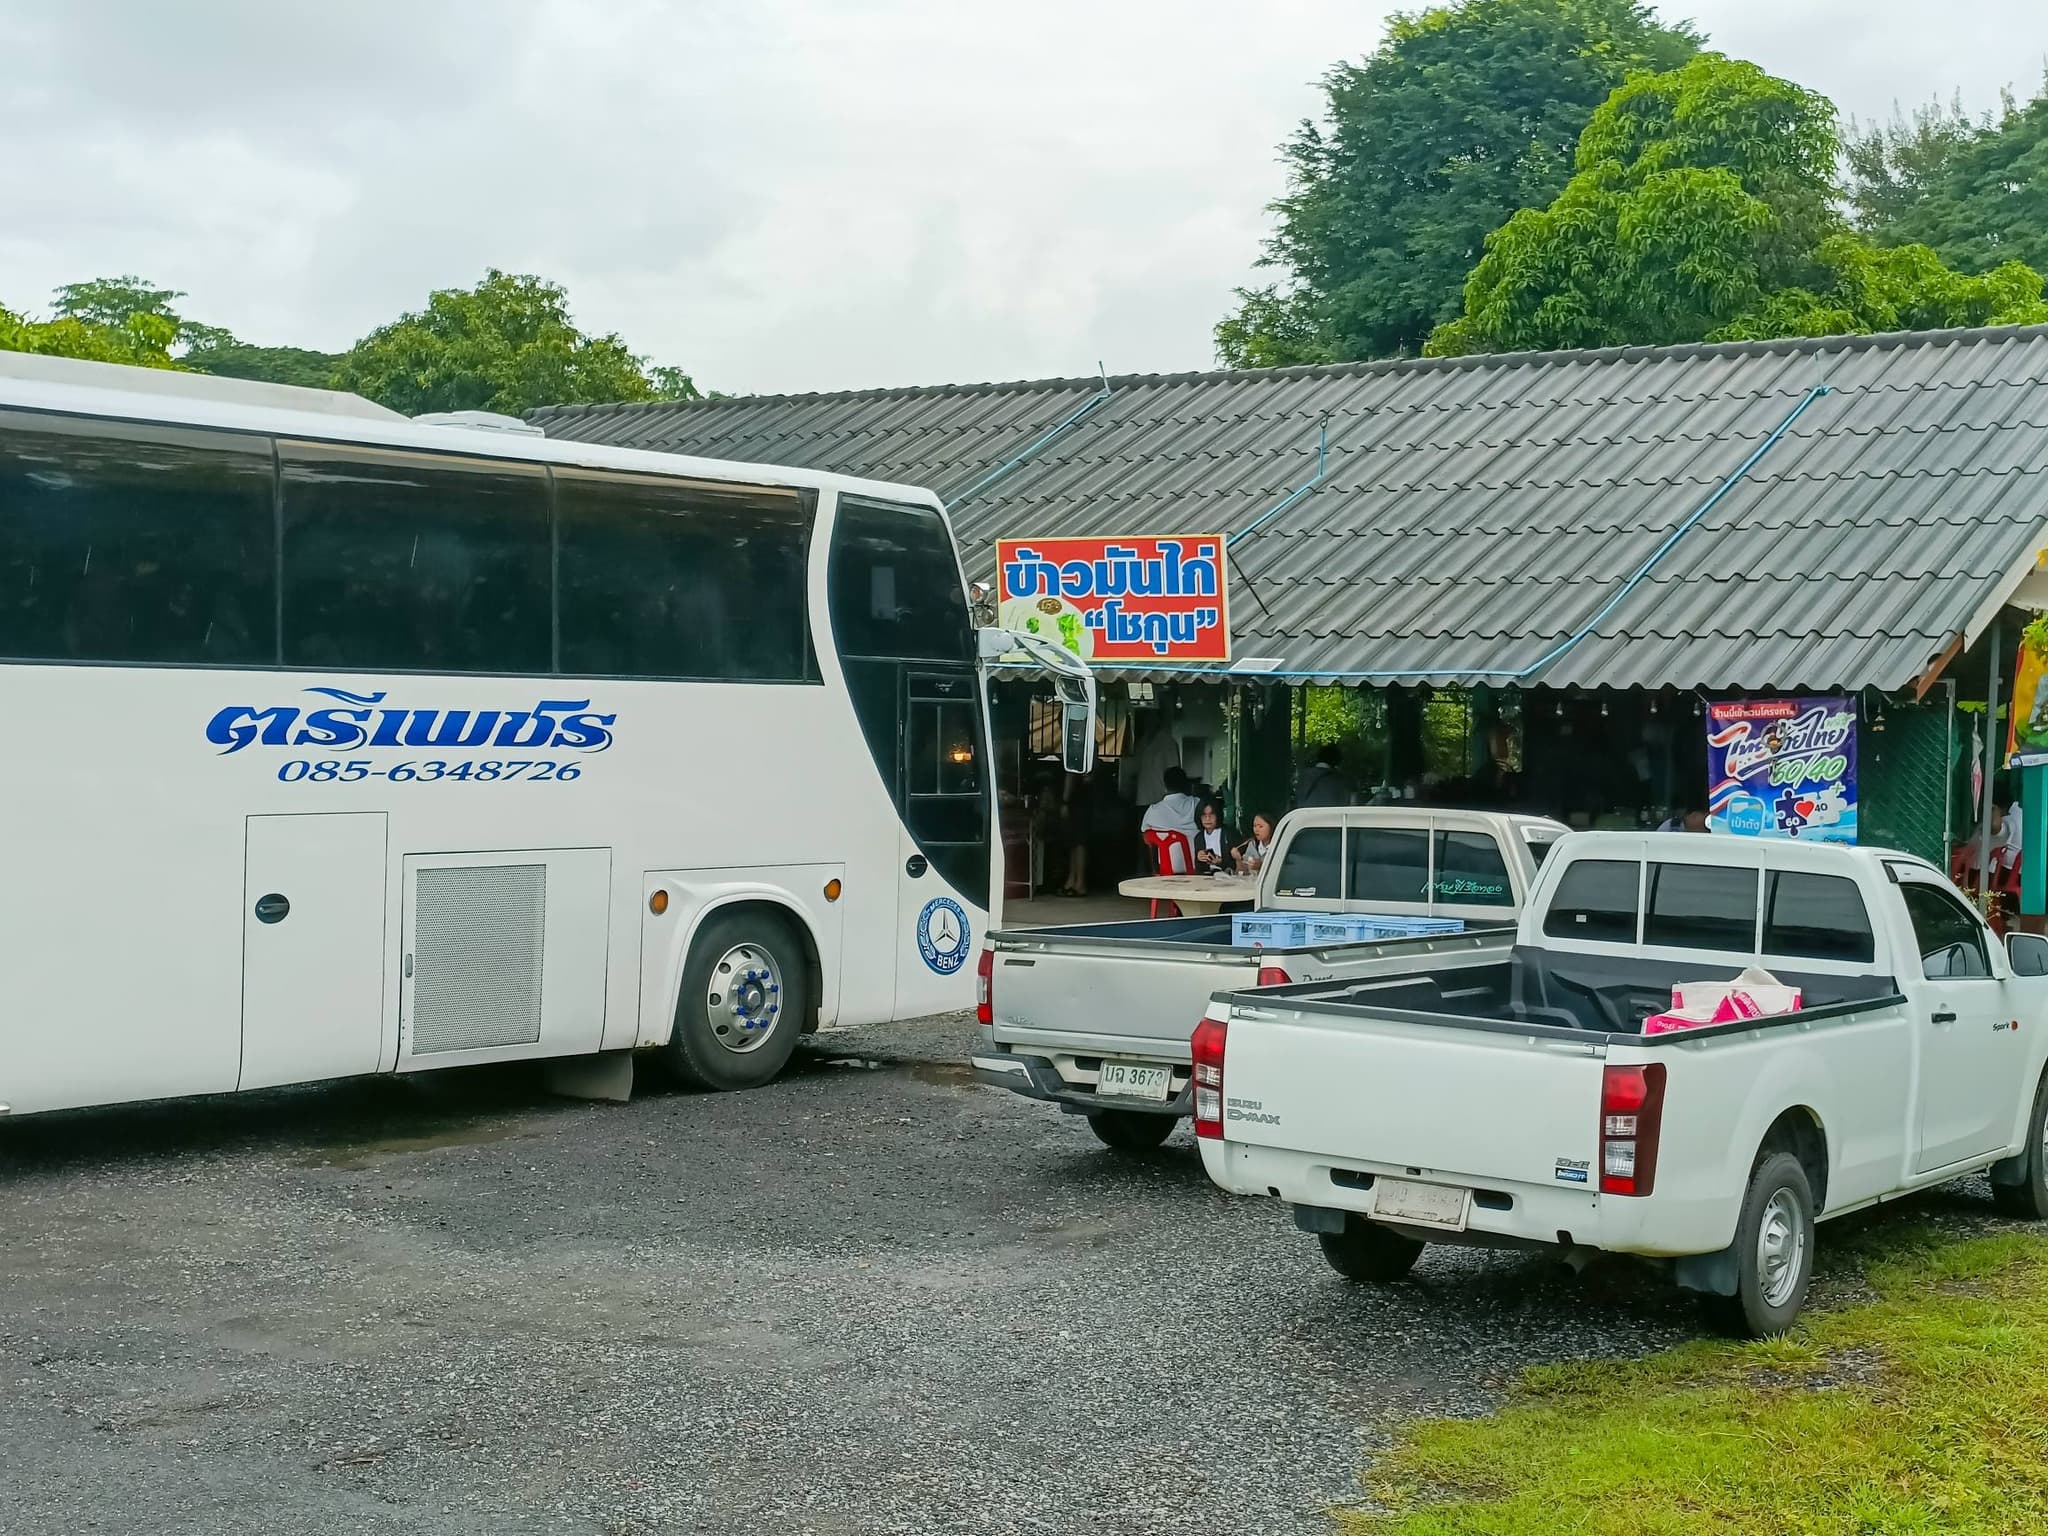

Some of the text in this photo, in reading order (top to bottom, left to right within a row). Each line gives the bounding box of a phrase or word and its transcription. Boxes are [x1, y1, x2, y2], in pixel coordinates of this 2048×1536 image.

[1004, 541, 1218, 598] ข้าวมันไก่
[205, 687, 617, 755] ตรีเพชร
[277, 760, 582, 783] 085-6348726
[1815, 802, 1828, 812] 40
[1785, 817, 1800, 826] 60
[936, 953, 960, 969] BENZ
[1130, 1069, 1163, 1087] 3673
